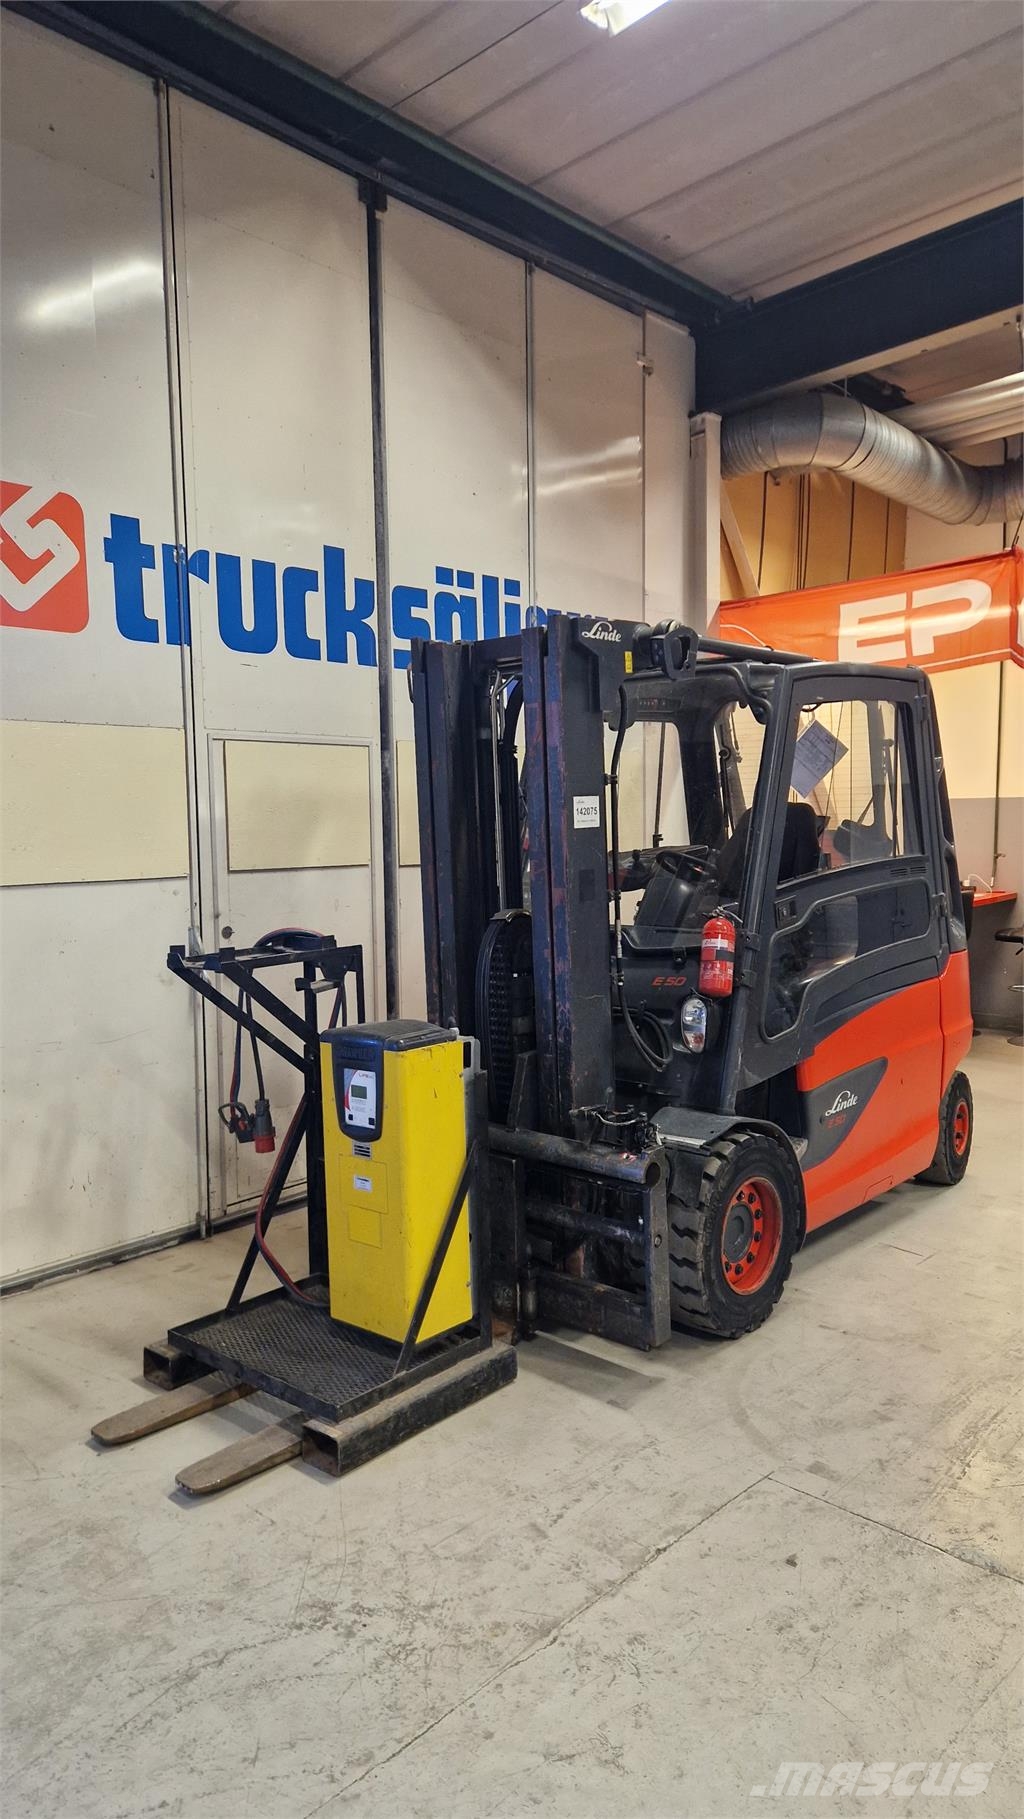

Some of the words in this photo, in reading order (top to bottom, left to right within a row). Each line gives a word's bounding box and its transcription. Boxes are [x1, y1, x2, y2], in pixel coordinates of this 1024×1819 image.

[581, 621, 622, 642] Linde
[838, 578, 992, 664] EP
[576, 806, 599, 816] 142075
[825, 1090, 858, 1117] Linde
